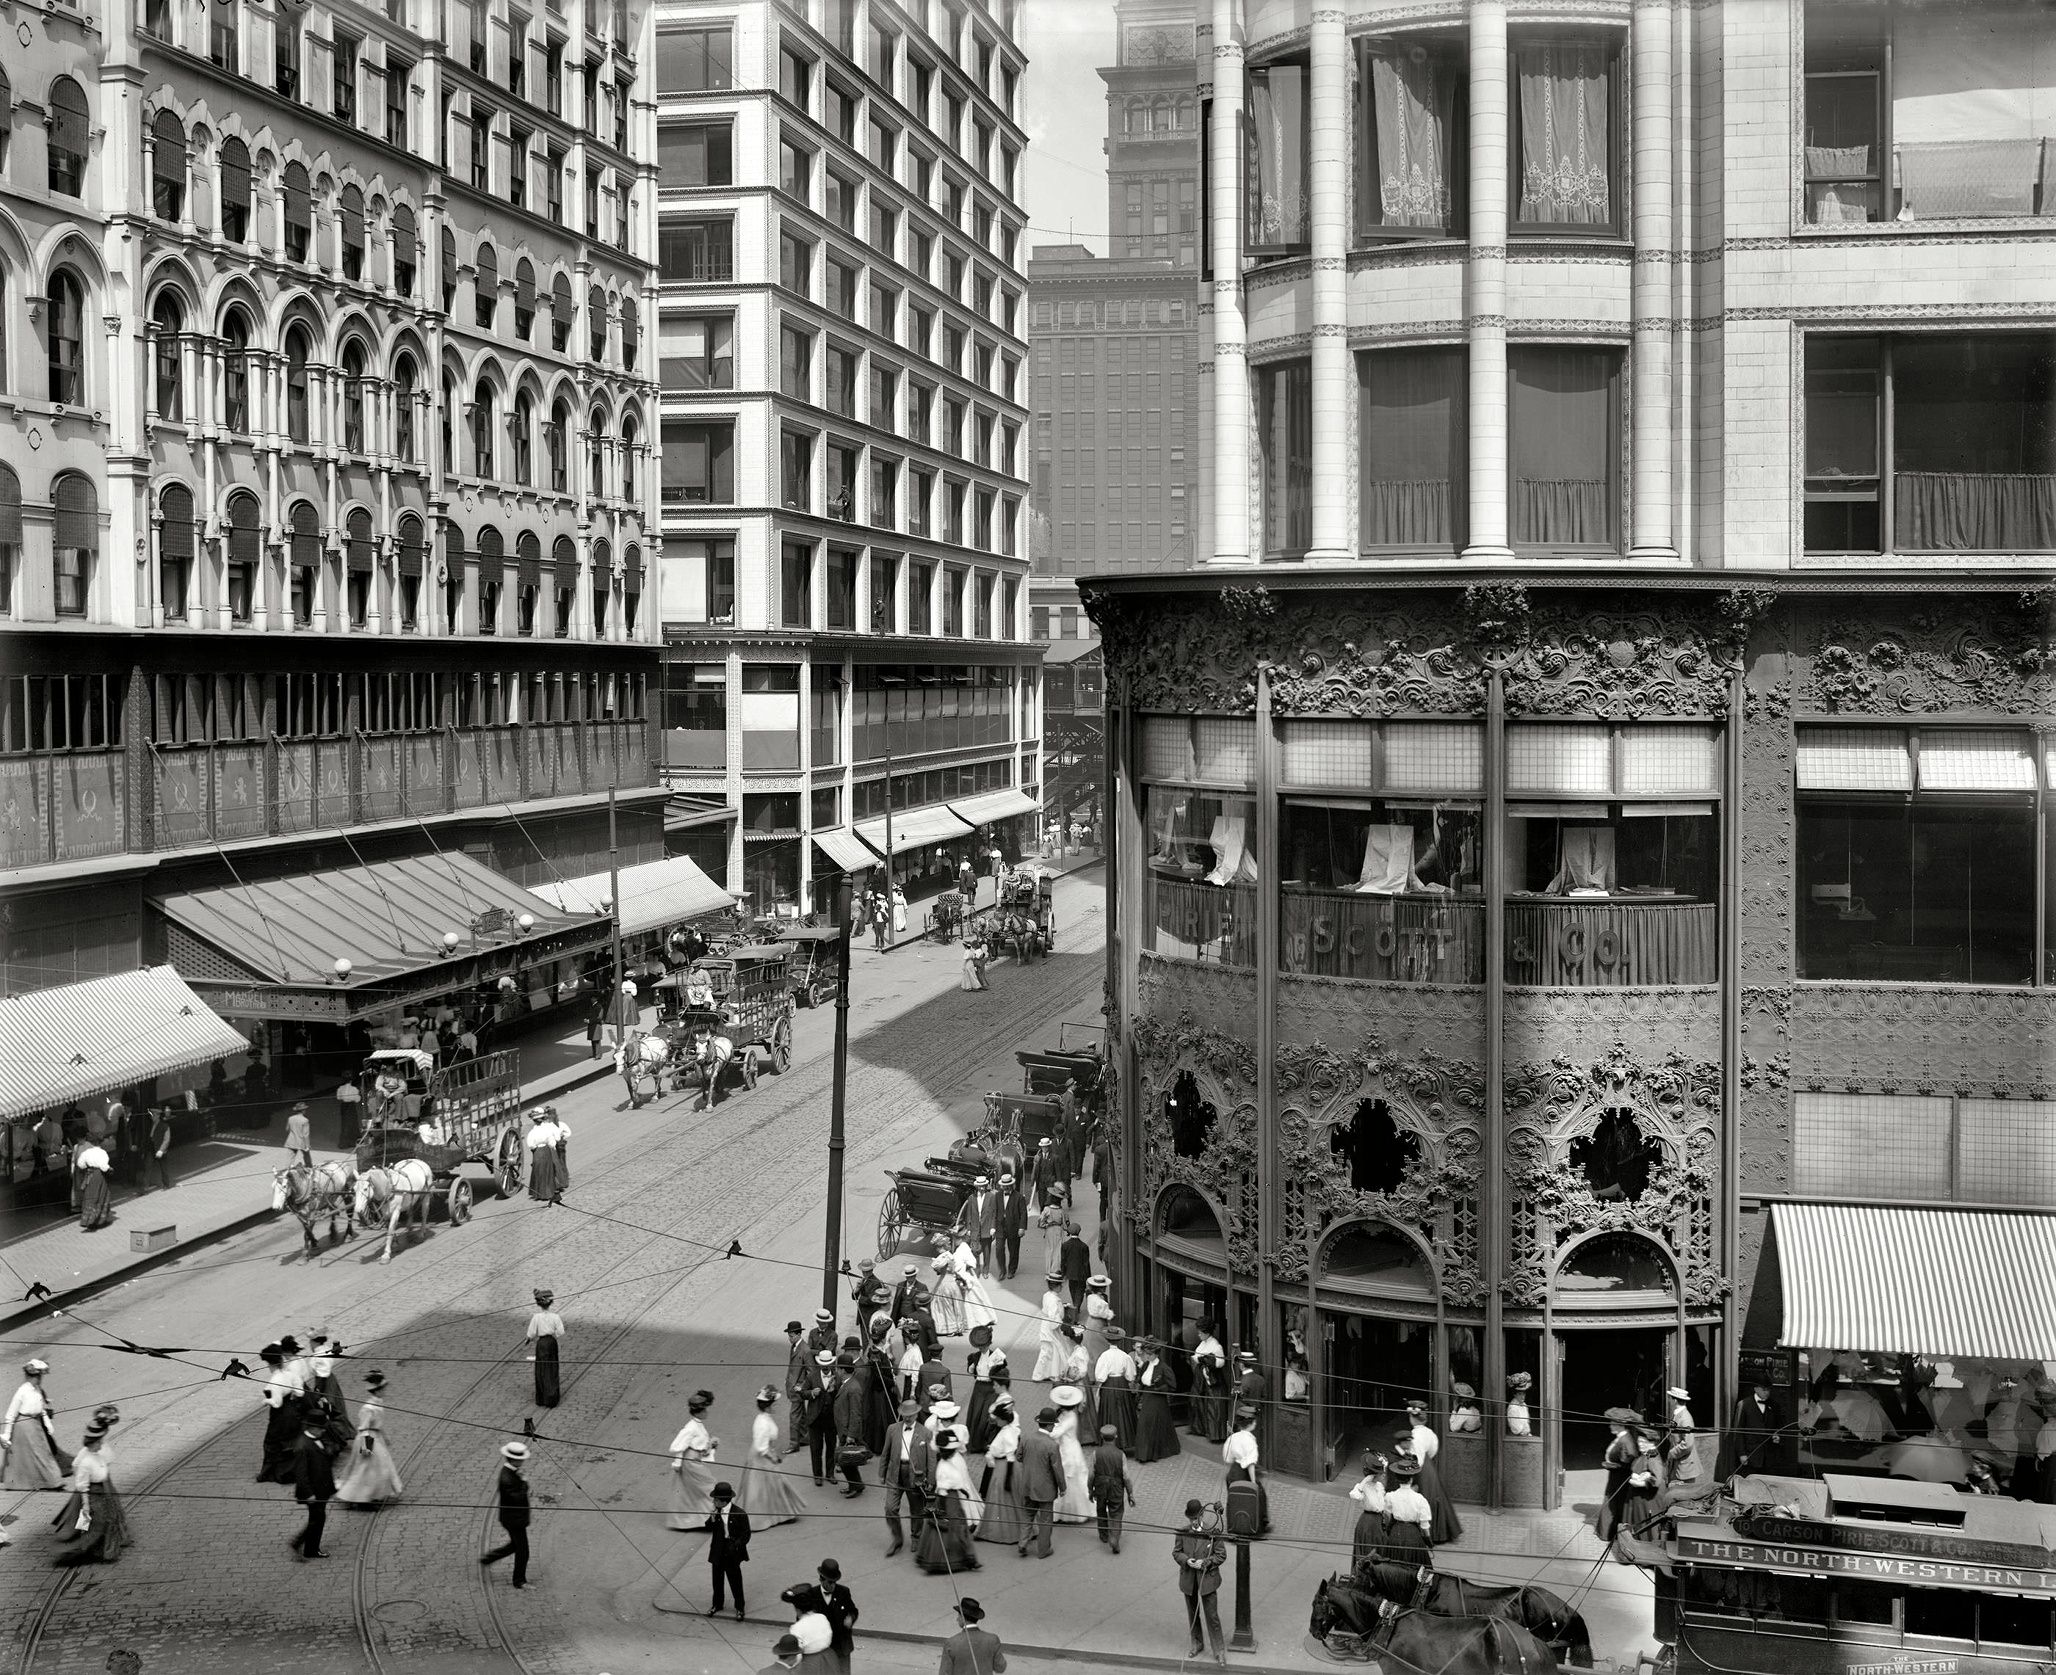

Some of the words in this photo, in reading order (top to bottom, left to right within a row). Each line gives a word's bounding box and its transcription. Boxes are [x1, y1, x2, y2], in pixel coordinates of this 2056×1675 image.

[1313, 914, 1453, 960] SCOTT
[1513, 935, 1538, 962] &
[1762, 1521, 1823, 1541] CARSON
[1878, 1533, 1928, 1551] SCOTT
[1691, 1541, 1754, 1560] THE
[1764, 1548, 2022, 1585] NORTH-WESTERN
[1849, 1661, 1956, 1675] NORTH-WESTERN
